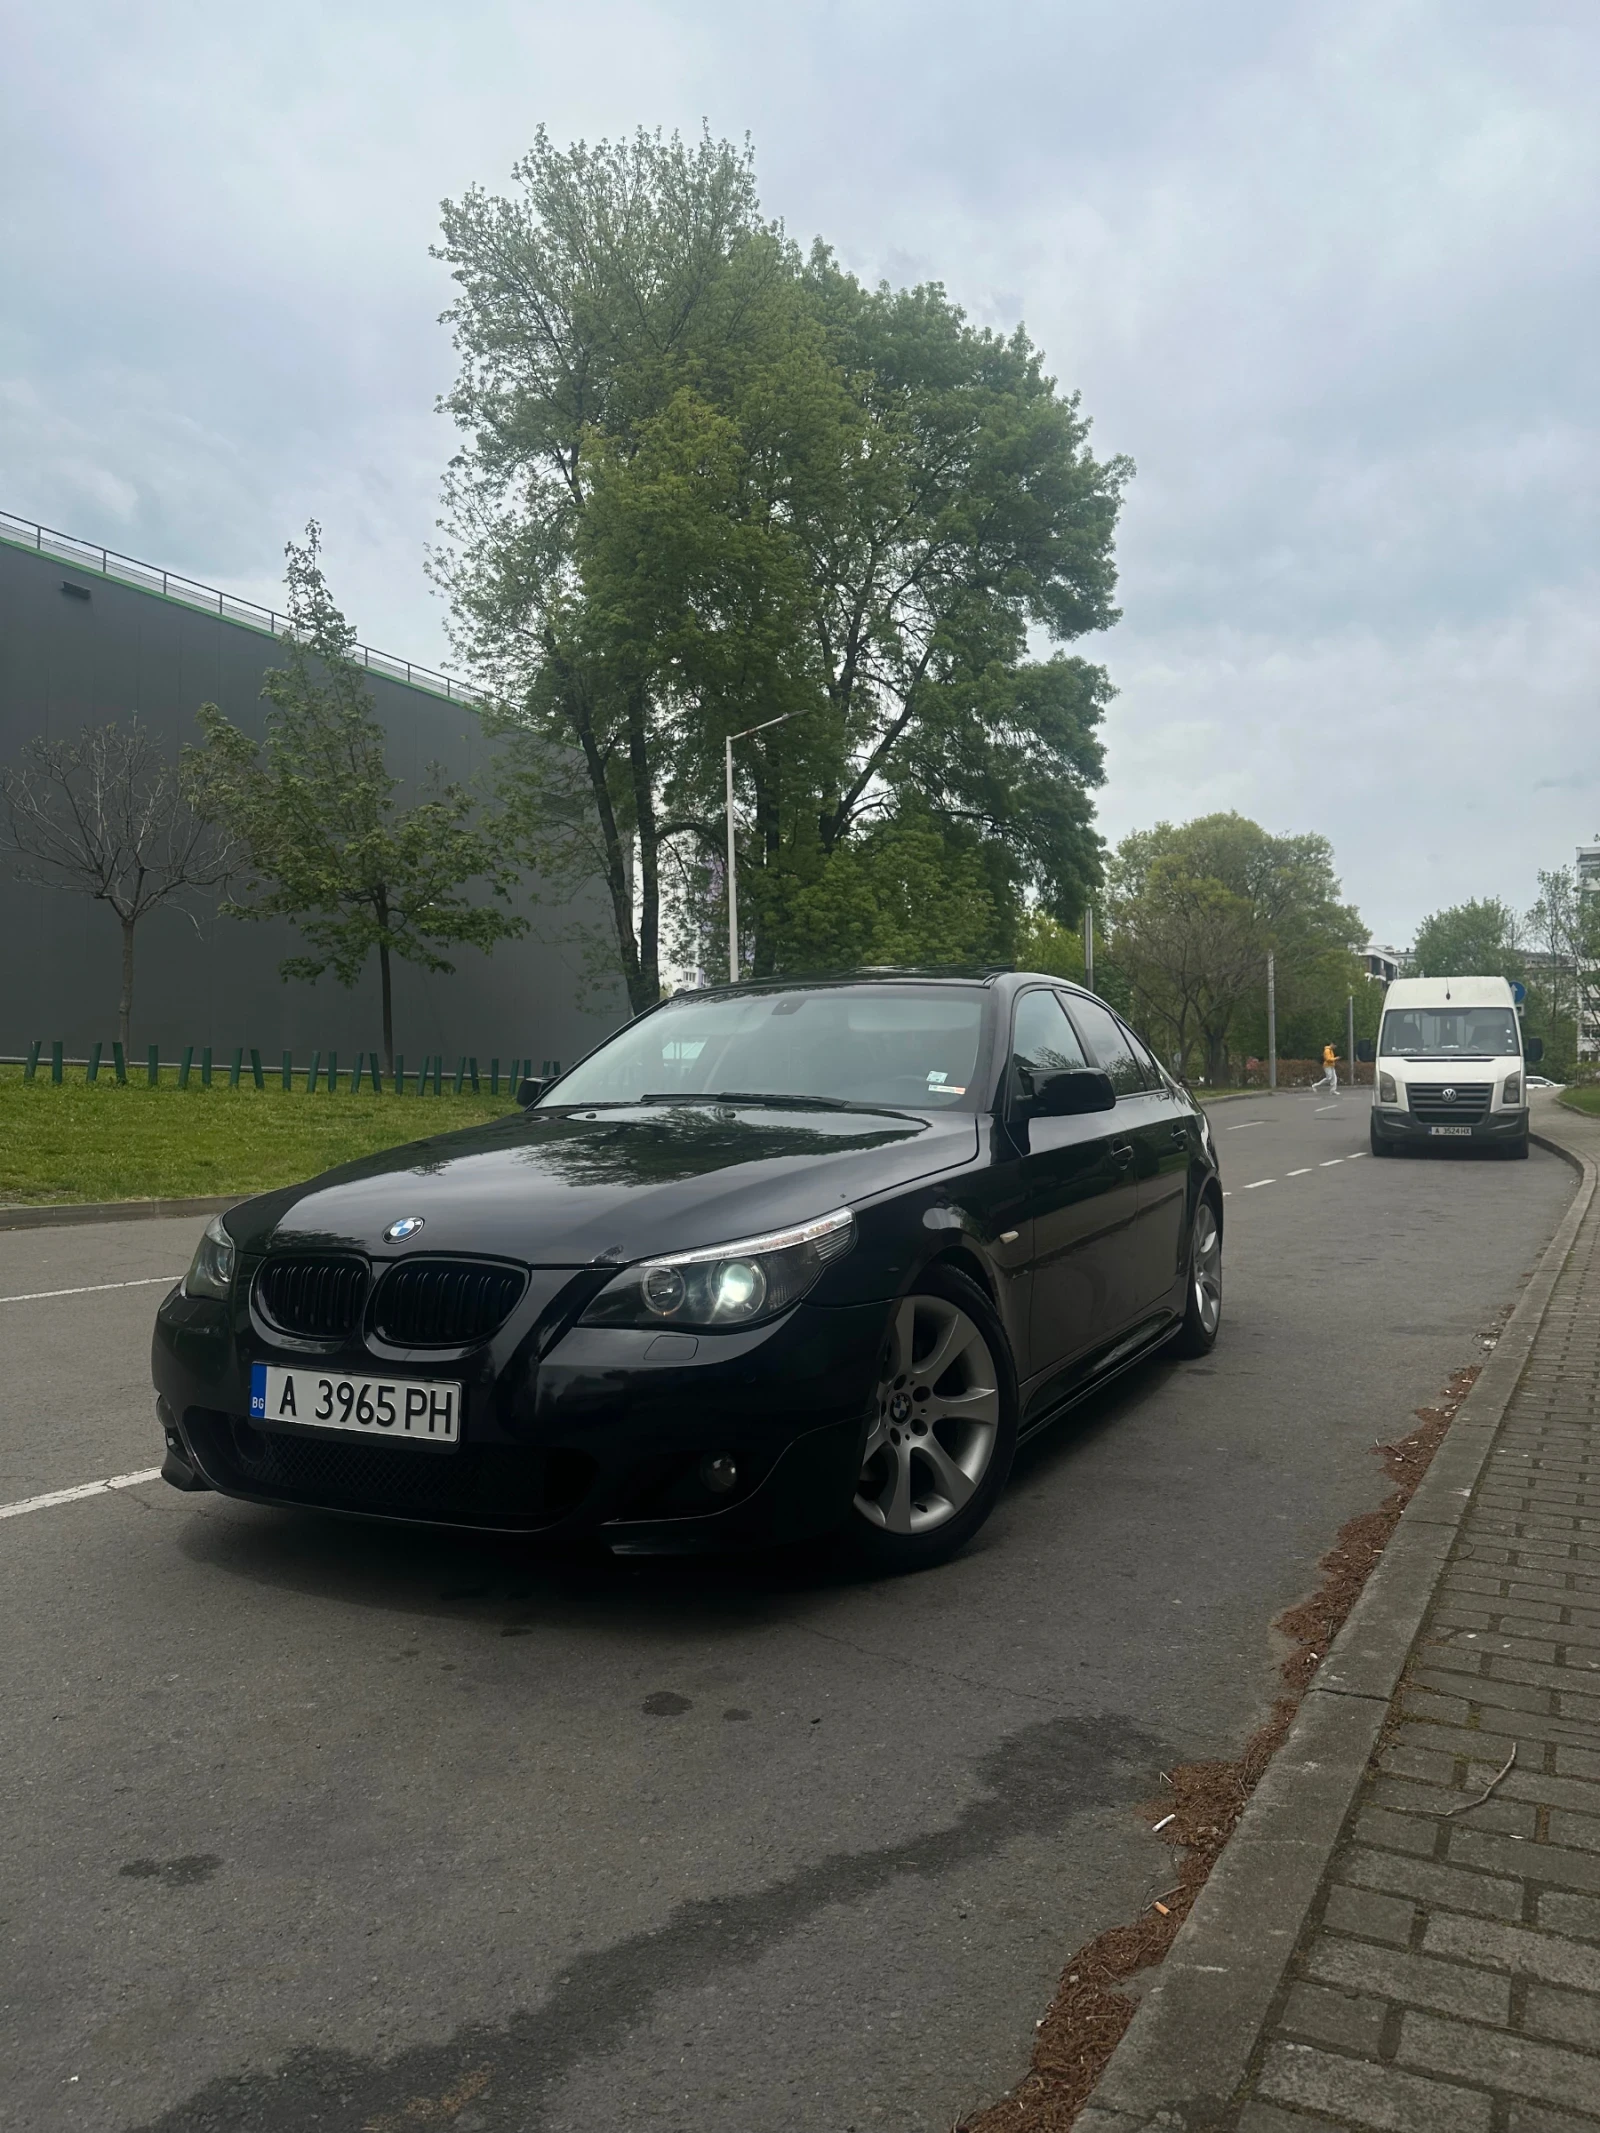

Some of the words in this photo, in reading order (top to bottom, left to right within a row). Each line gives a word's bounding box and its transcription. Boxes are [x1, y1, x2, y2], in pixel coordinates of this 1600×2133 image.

[252, 1396, 265, 1410] BG
[279, 1375, 297, 1416] A
[315, 1379, 396, 1427] 3965
[404, 1387, 453, 1434] PH
